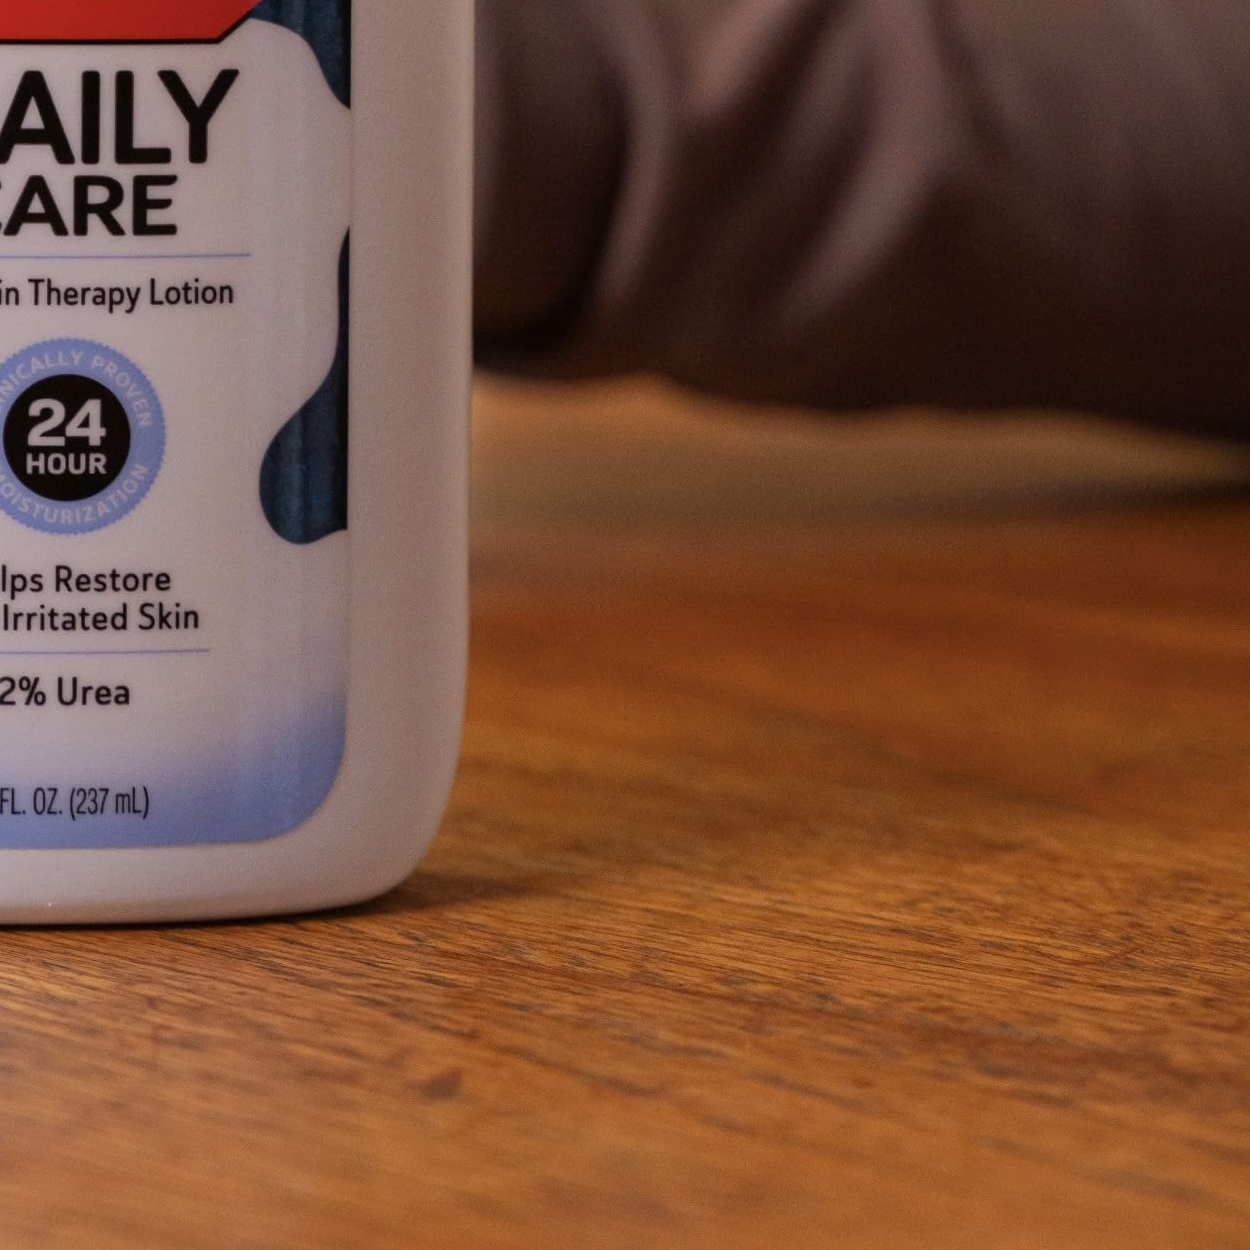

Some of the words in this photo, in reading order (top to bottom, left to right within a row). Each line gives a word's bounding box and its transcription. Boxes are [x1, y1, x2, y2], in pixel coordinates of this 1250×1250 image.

[27, 276, 141, 313] Therapy
[148, 277, 235, 305] Lotion
[89, 353, 153, 429] PROVEN
[26, 397, 107, 448] 24
[25, 452, 107, 476] HOUR
[53, 565, 172, 594] Restore
[2, 602, 128, 631] Irritated
[138, 602, 200, 630] Skin
[56, 677, 131, 706] Urea
[32, 787, 63, 816] OZ.
[69, 786, 111, 820] (237
[114, 786, 151, 820] mL)
